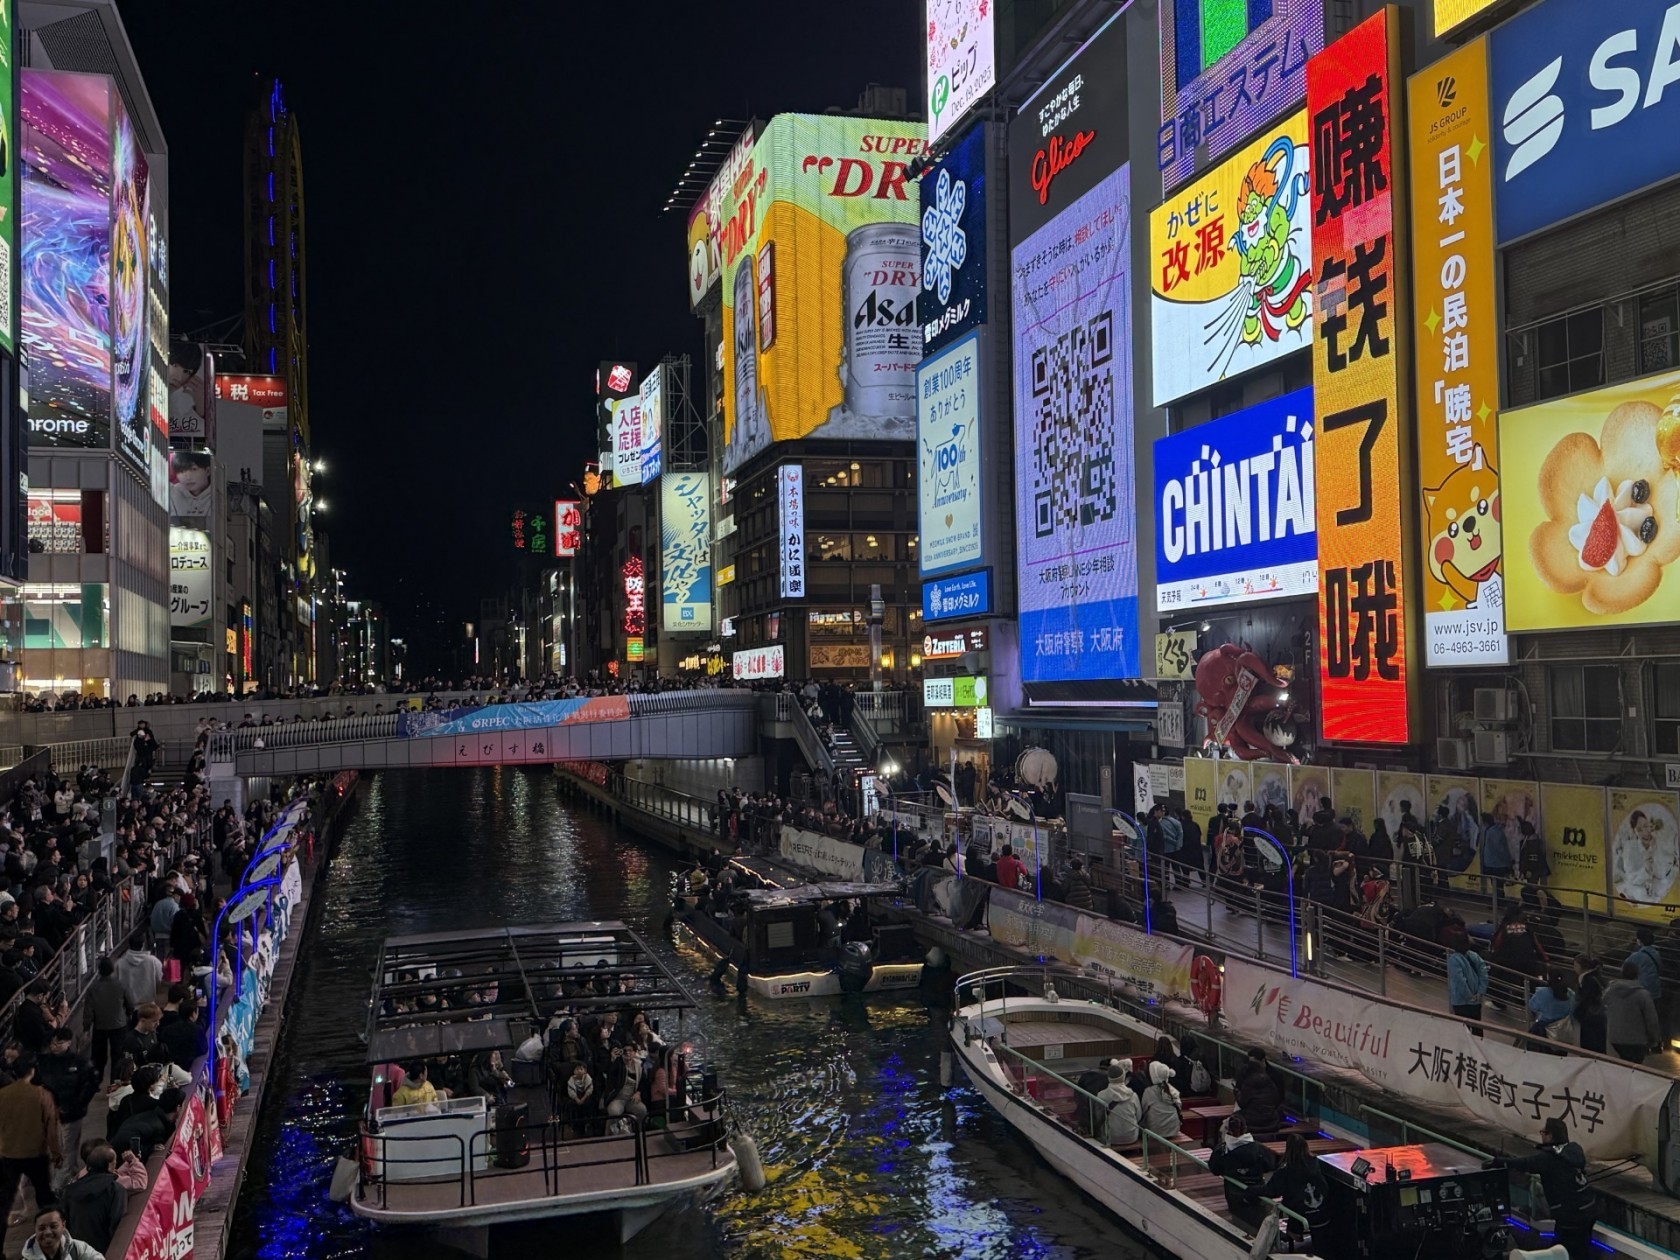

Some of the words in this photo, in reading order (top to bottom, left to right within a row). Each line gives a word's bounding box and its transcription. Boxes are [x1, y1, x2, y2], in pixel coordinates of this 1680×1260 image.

[951, 41, 978, 93] ピップ
[951, 97, 965, 117] Dec.
[1157, 28, 1310, 171] 日商エステム
[1042, 100, 1081, 137] ゆたかな人生
[1429, 122, 1439, 134] JS
[1440, 106, 1467, 128] GROUP
[860, 134, 933, 156] SUPER
[1031, 130, 1095, 205] Glico
[1167, 189, 1219, 239] かぜに
[882, 260, 914, 270] SUPER
[1161, 212, 1225, 292] 改源
[924, 298, 971, 344] 雪印メグミルク
[888, 334, 910, 349] 生
[923, 355, 972, 400] 創業100周年
[252, 389, 264, 397] Tax
[929, 388, 967, 423] ありがとう
[618, 406, 641, 430] 入店
[618, 428, 641, 452] 応援
[938, 444, 957, 472] 100
[788, 486, 800, 528] 本場の味
[1162, 425, 1317, 564] CHINTAI
[942, 592, 979, 613] 雪印メグミルク
[1060, 581, 1090, 599] アカウント
[171, 597, 209, 615] グループ
[1434, 619, 1499, 636] www.jsv.jp
[932, 638, 967, 655] ZETTERIA
[1035, 631, 1084, 656] 大阪府警察
[1090, 626, 1124, 653] 大阪府
[1433, 640, 1501, 655] 06-4963-3661
[458, 741, 546, 758] えびす橋
[1553, 851, 1598, 864] mikkeLIVE
[781, 981, 810, 995] PARTY
[1293, 1004, 1391, 1059] Beautiful
[1408, 1041, 1606, 1134] 大阪樟蔭女子大学
